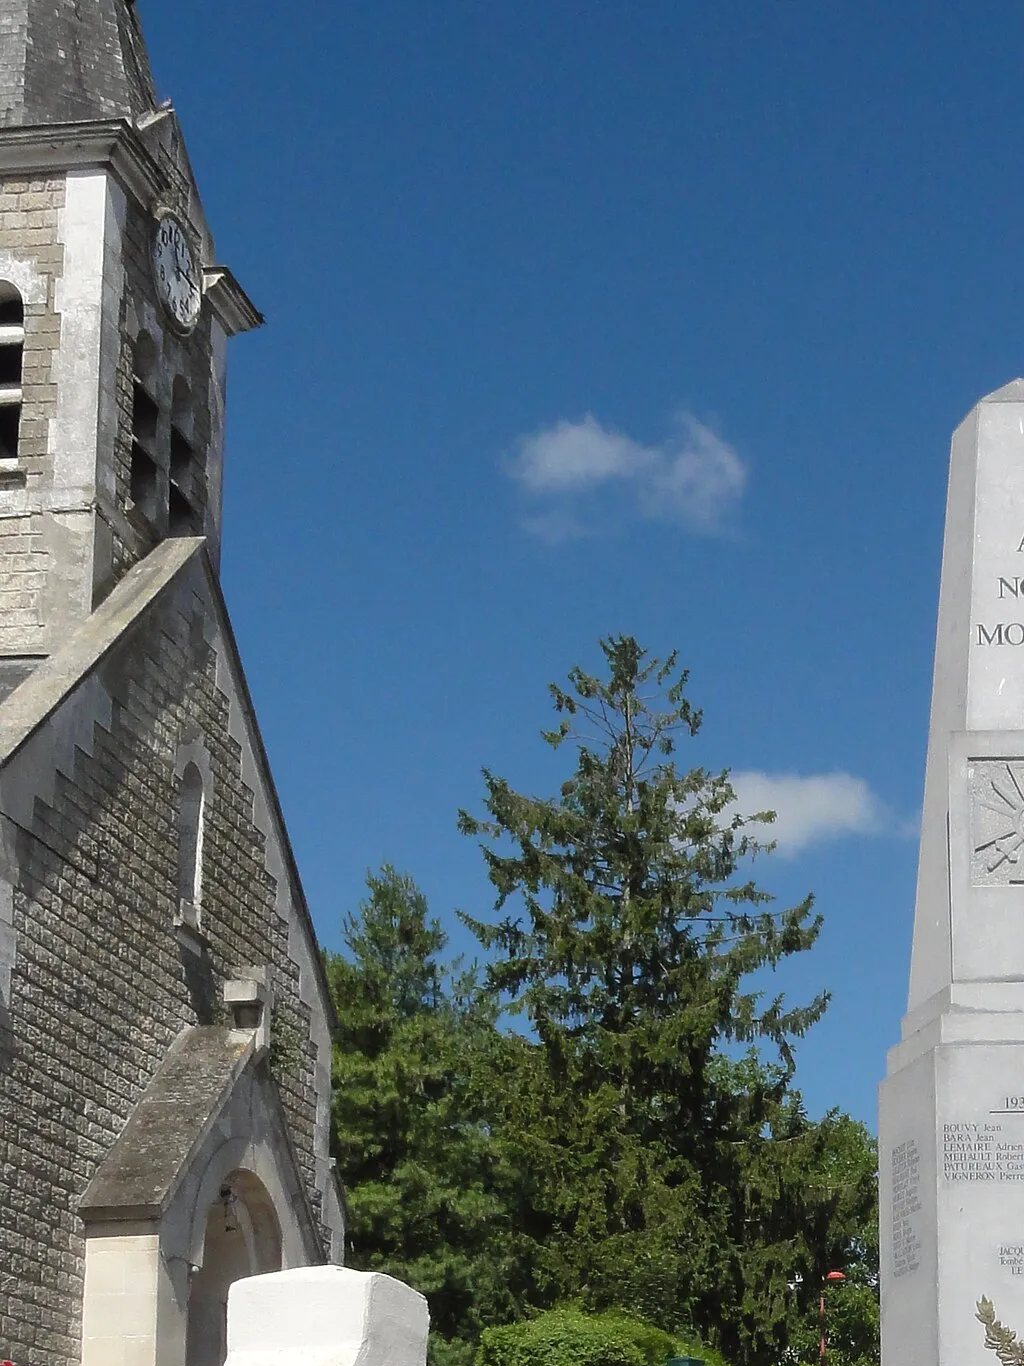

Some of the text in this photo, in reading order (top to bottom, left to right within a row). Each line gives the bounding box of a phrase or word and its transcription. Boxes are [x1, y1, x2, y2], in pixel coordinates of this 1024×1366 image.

[944, 1124, 978, 1132] BOUVY
[944, 1134, 971, 1142] BARA
[944, 1153, 992, 1161] MEHAULT
[944, 1163, 1002, 1171] PATUREAUX
[944, 1172, 995, 1180] VIGNERON
[999, 1257, 1022, 1265] Tombé
